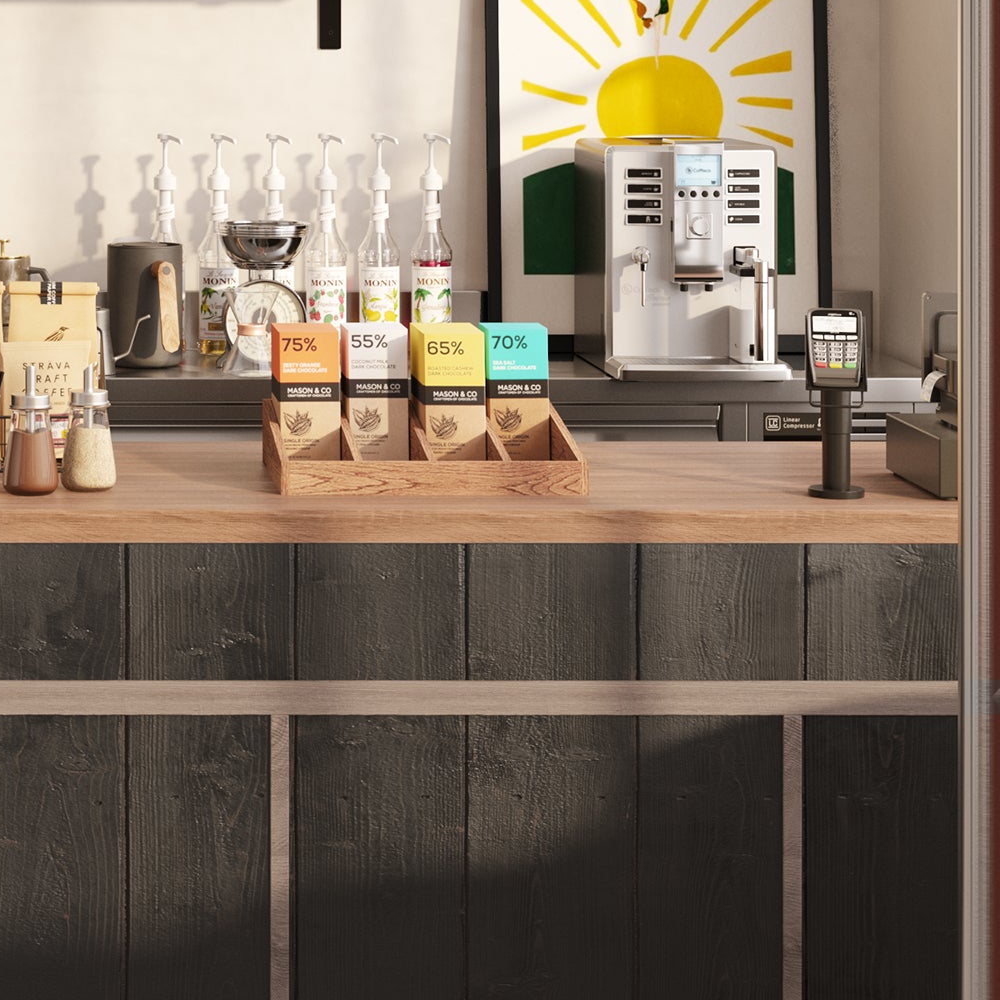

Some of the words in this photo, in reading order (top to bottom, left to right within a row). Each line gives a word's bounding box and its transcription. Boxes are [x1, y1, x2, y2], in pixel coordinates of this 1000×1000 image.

[203, 277, 237, 285] MONIN
[311, 279, 344, 287] MONIN
[364, 279, 397, 287] MONIN
[417, 277, 450, 286] MONIN
[282, 338, 317, 351] 75%
[352, 335, 388, 348] 55%
[492, 336, 527, 349] 70%
[428, 341, 464, 355] 65%
[36, 374, 68, 383] RAFT
